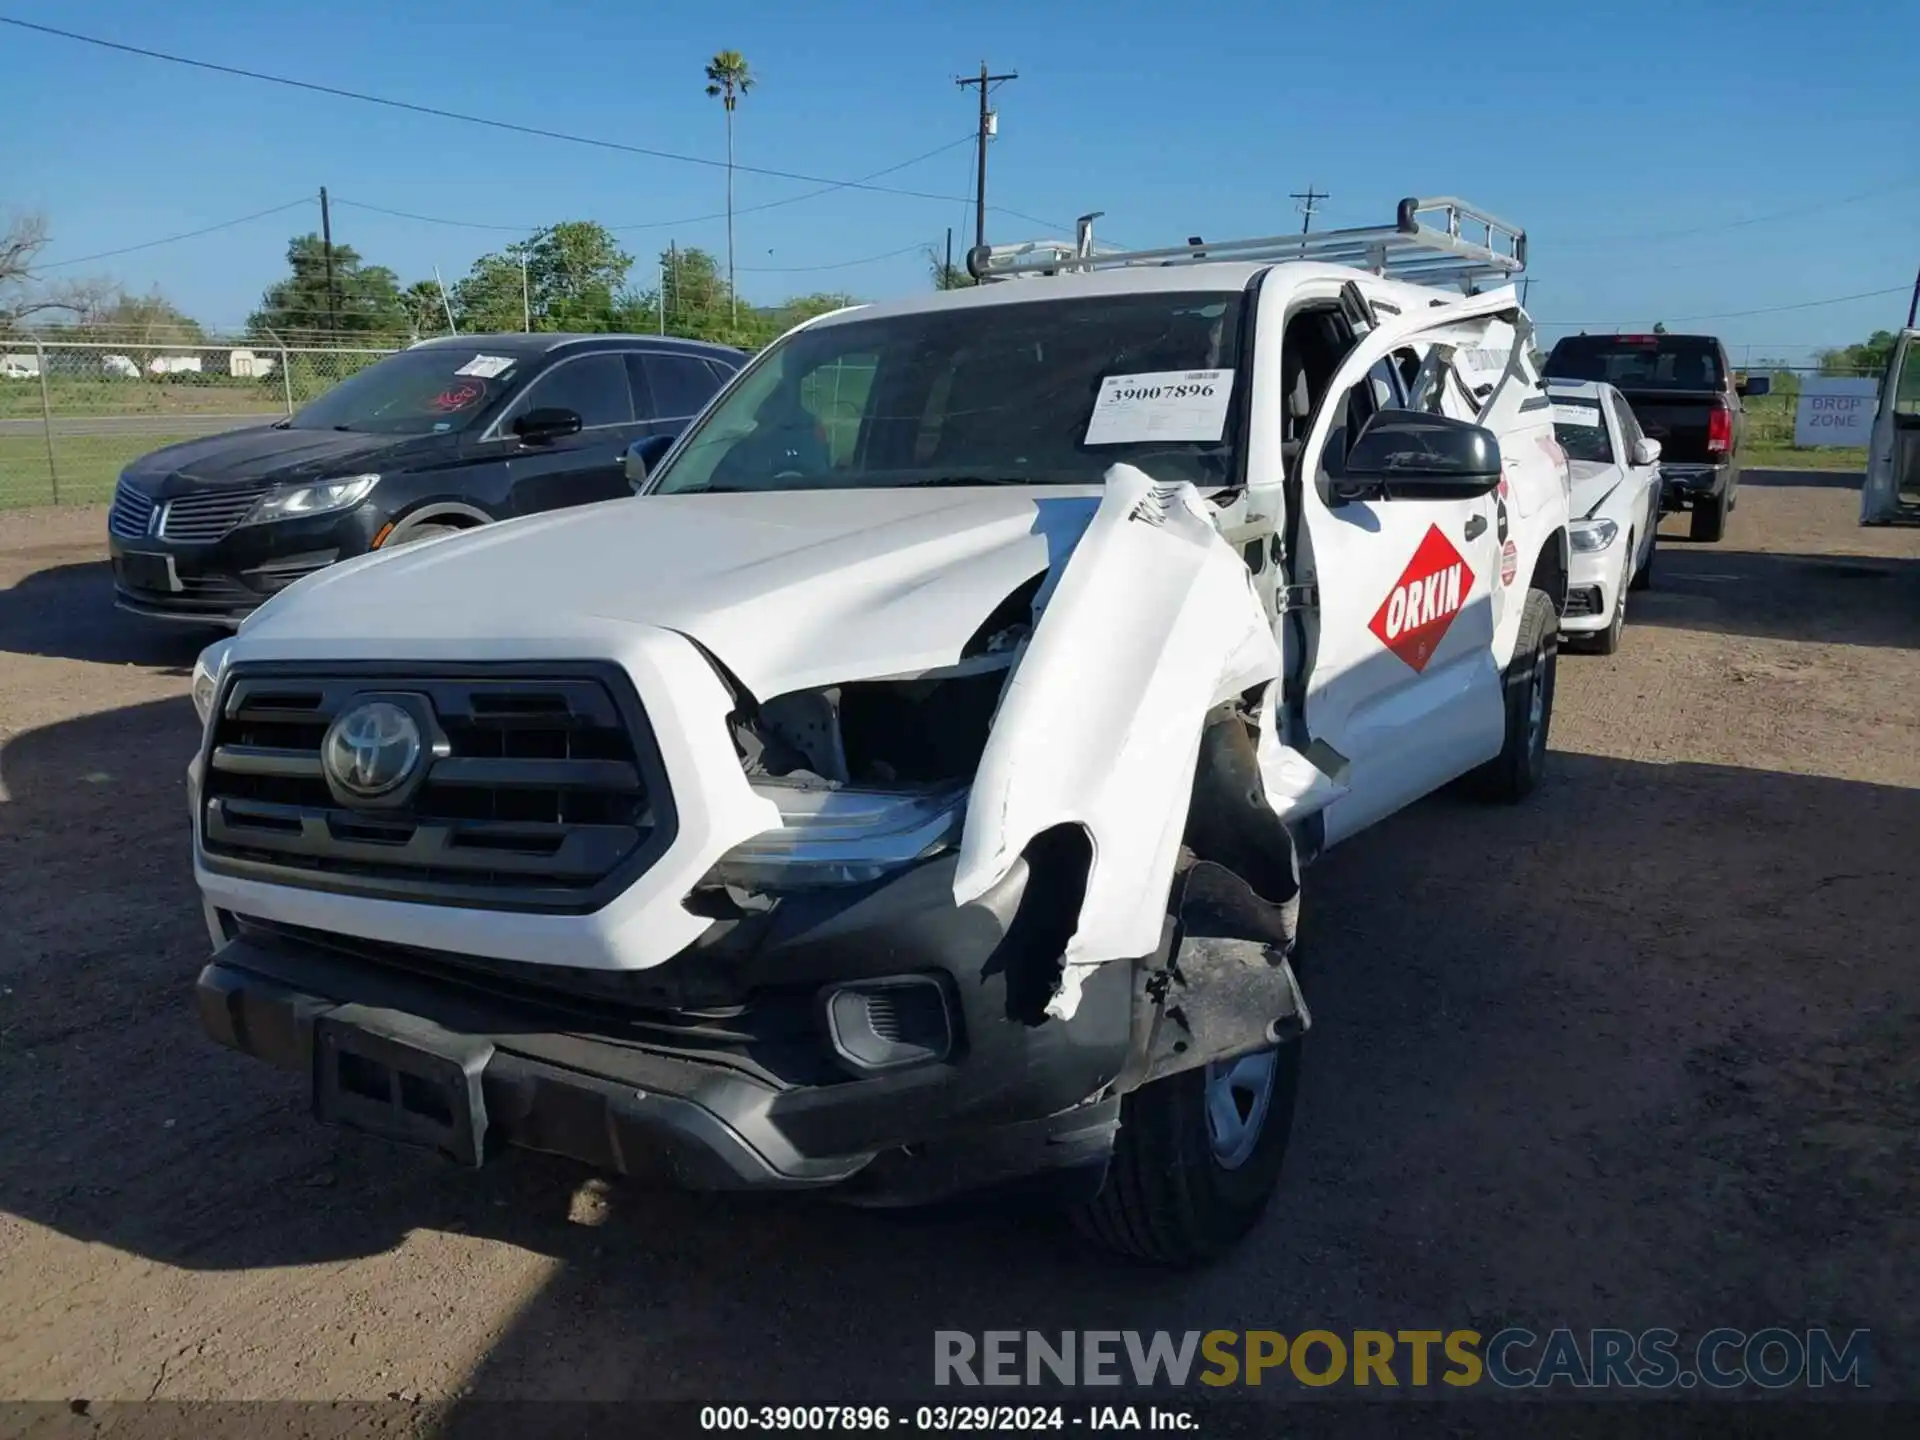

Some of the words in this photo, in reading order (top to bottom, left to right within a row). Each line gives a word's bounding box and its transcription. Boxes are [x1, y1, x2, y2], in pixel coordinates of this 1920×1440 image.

[1109, 383, 1215, 403] 39007896
[1811, 397, 1860, 412] DROP
[1809, 413, 1858, 428] ZONE
[1385, 561, 1463, 641] ORKIN
